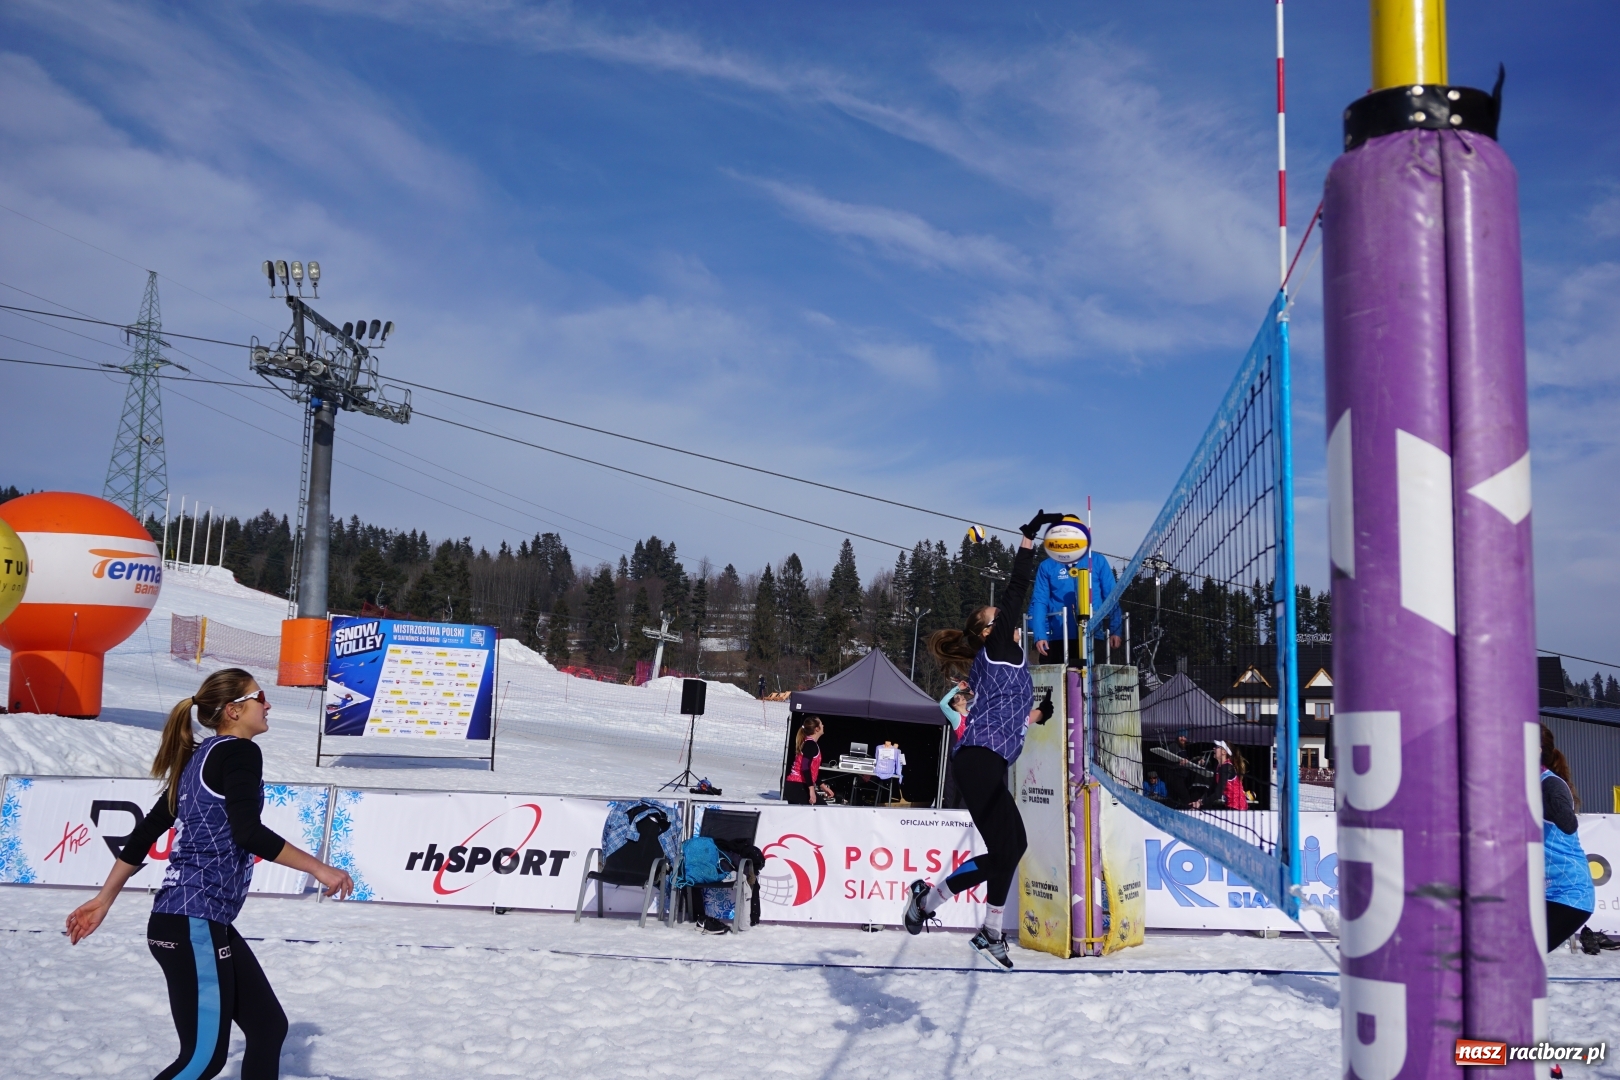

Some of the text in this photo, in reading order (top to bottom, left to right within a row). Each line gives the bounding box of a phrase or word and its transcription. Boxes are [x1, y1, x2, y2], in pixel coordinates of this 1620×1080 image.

[335, 621, 379, 643] SNOW
[393, 623, 440, 636] MISTRZOSTWA
[442, 626, 465, 638] POLSKI
[334, 633, 384, 657] VOLLEY
[900, 818, 974, 829] OFICJALNY PARTNER
[844, 845, 972, 875] POLSK
